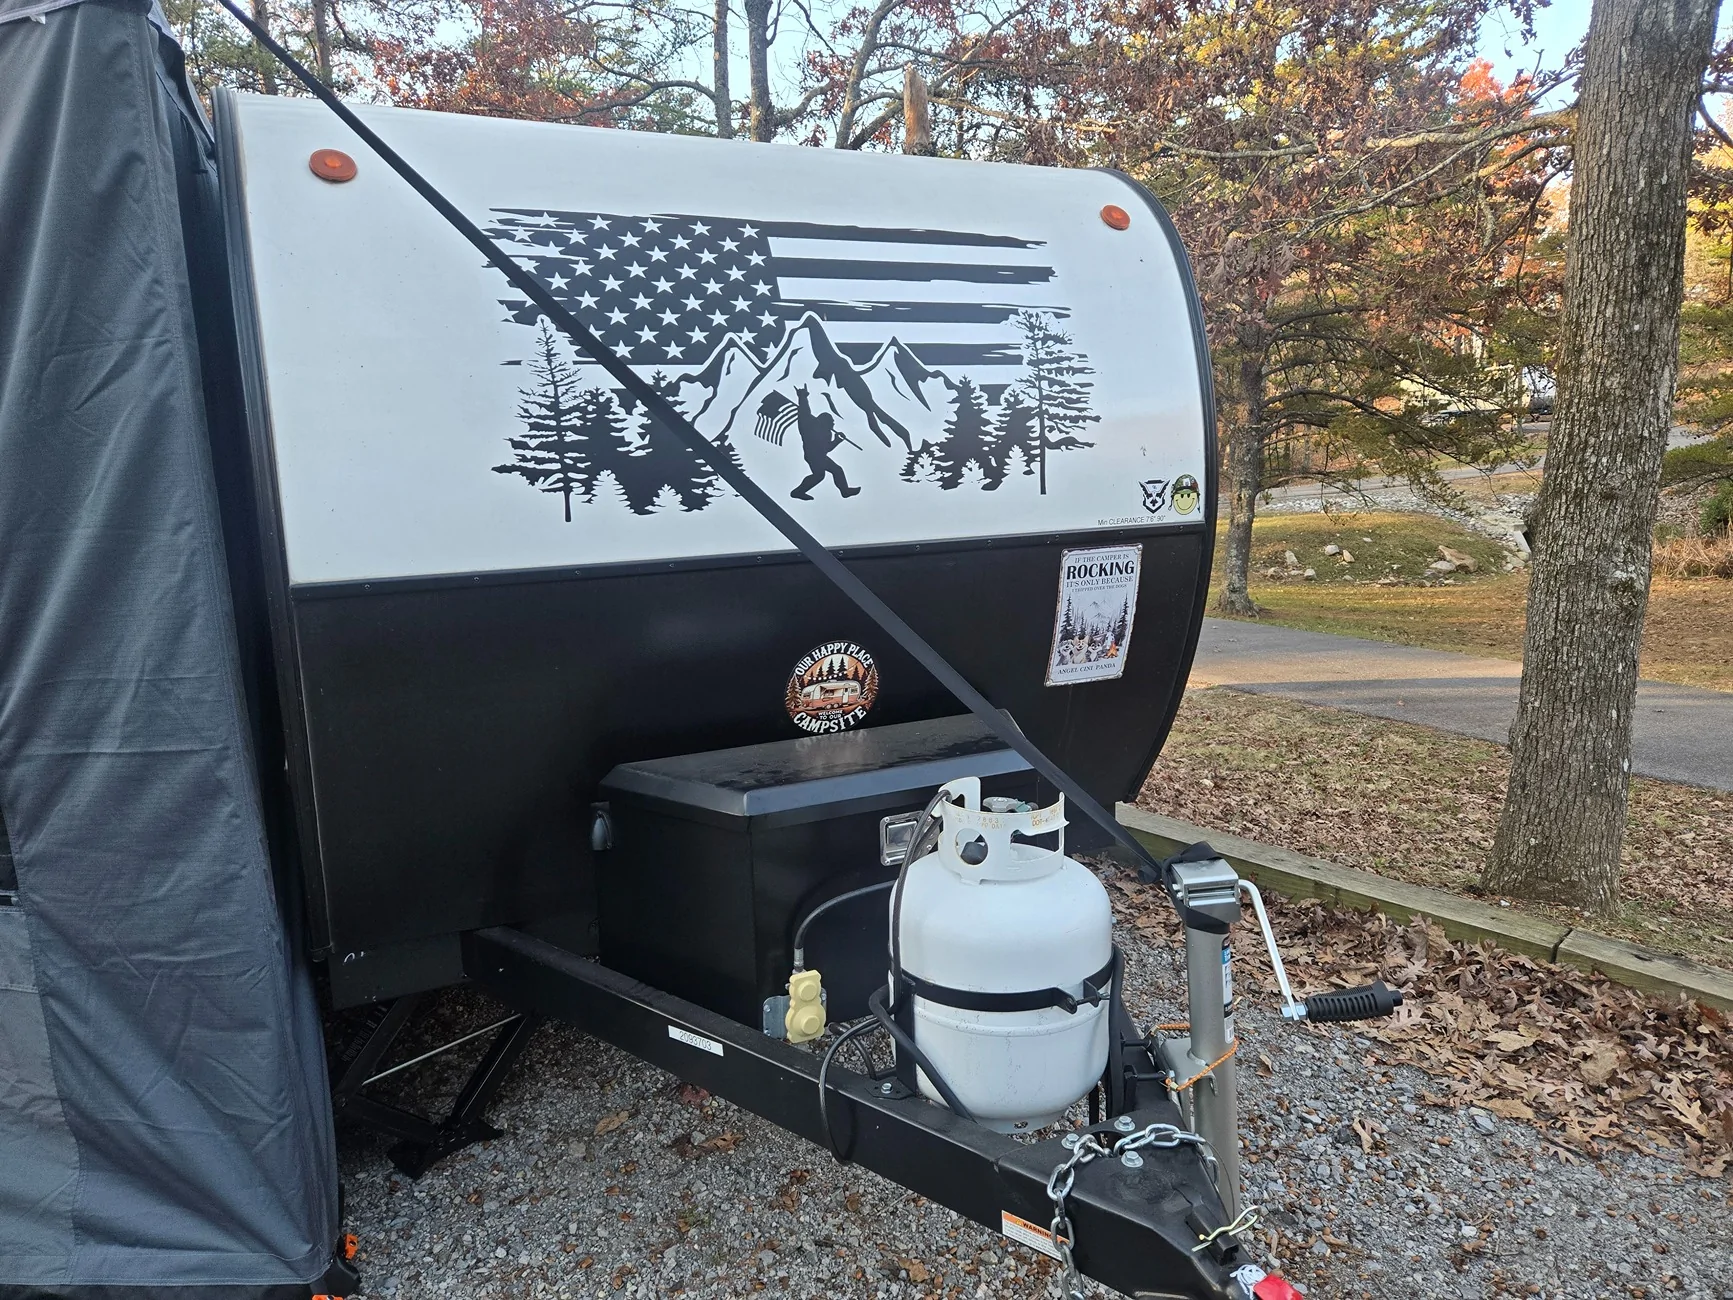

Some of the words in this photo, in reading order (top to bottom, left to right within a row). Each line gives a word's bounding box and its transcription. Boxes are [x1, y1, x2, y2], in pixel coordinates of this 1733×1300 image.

[1108, 516, 1145, 525] CLEARANCE
[1096, 554, 1122, 562] CAMPER
[1066, 560, 1134, 580] ROCKING
[1101, 576, 1134, 585] BECAUSE
[795, 656, 814, 676] OUR
[812, 642, 848, 660] HAPPY
[846, 643, 874, 668] PLACE
[793, 706, 867, 733] CAMPSITE
